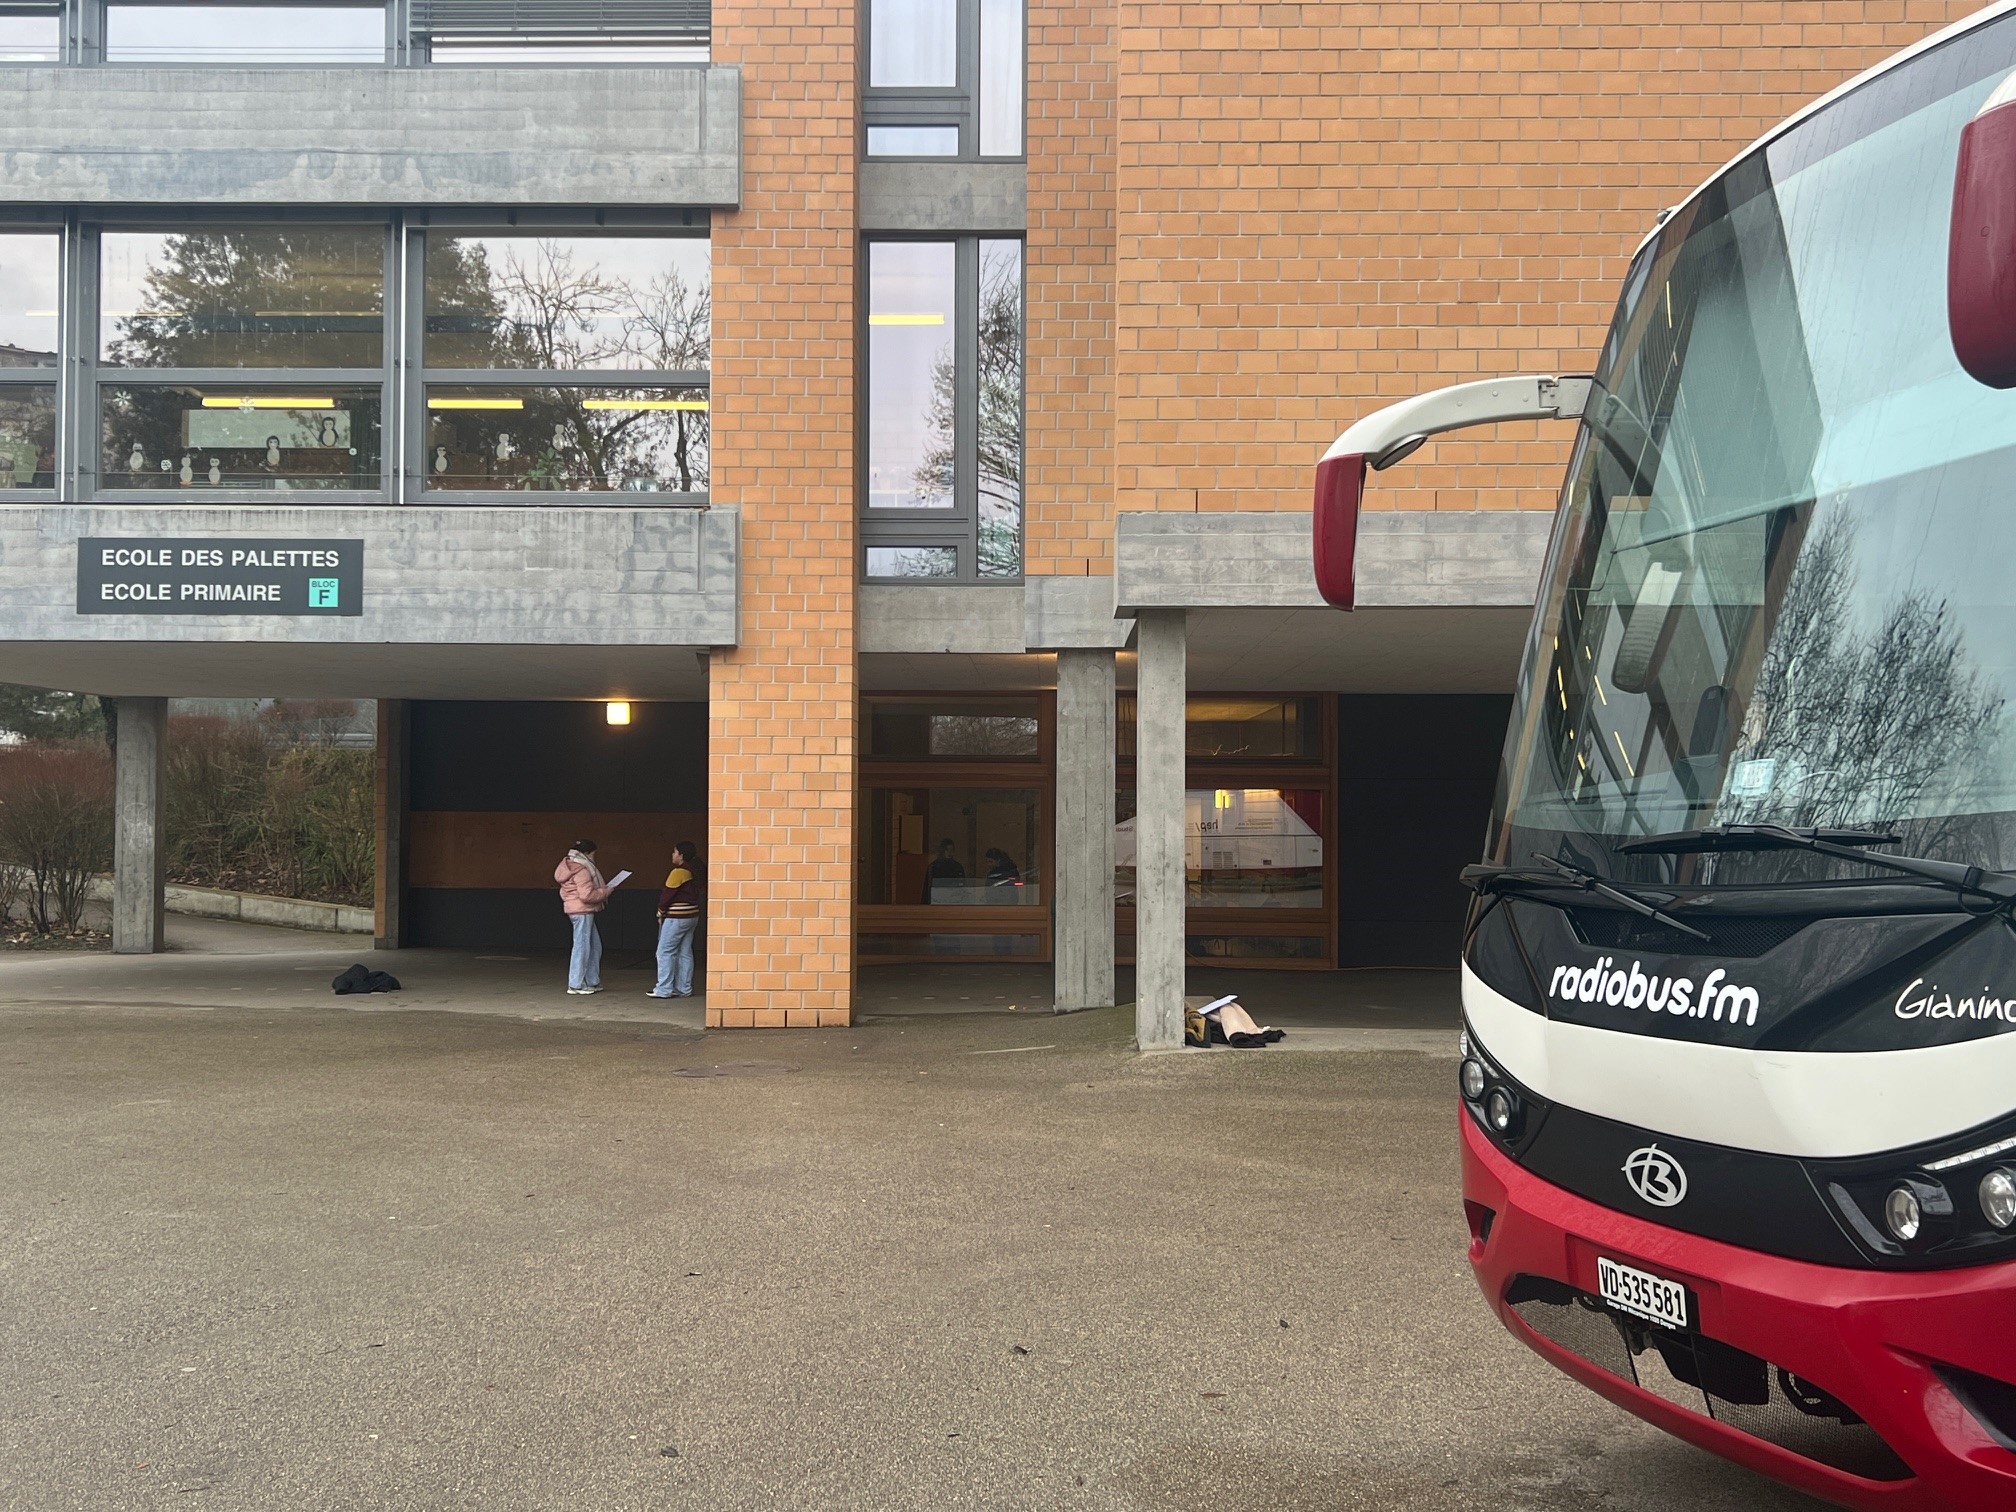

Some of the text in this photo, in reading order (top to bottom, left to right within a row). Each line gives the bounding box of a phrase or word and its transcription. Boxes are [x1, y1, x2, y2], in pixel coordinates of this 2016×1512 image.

[102, 549, 339, 567] ECOLE DES PALETTES
[101, 584, 281, 601] ECOLE PRIMAIRE
[311, 580, 335, 588] BLOC
[318, 589, 330, 605] F
[1549, 956, 1760, 1027] radiobus.fm
